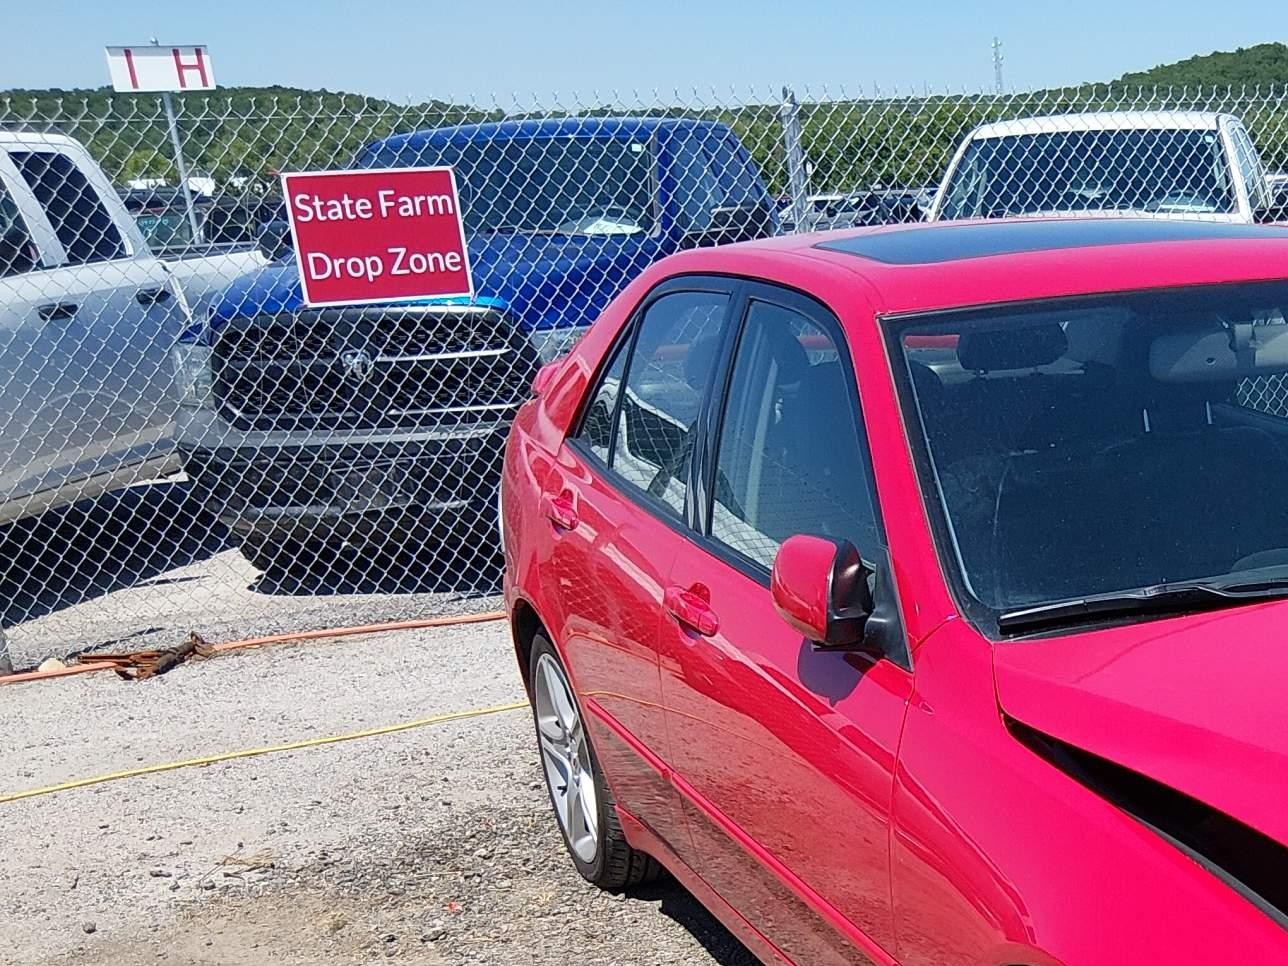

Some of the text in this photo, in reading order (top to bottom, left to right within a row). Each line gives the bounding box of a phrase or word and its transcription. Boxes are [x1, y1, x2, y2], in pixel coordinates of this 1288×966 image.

[172, 48, 209, 88] H
[294, 189, 454, 222] State Farm
[307, 247, 462, 282] Drop Zone
